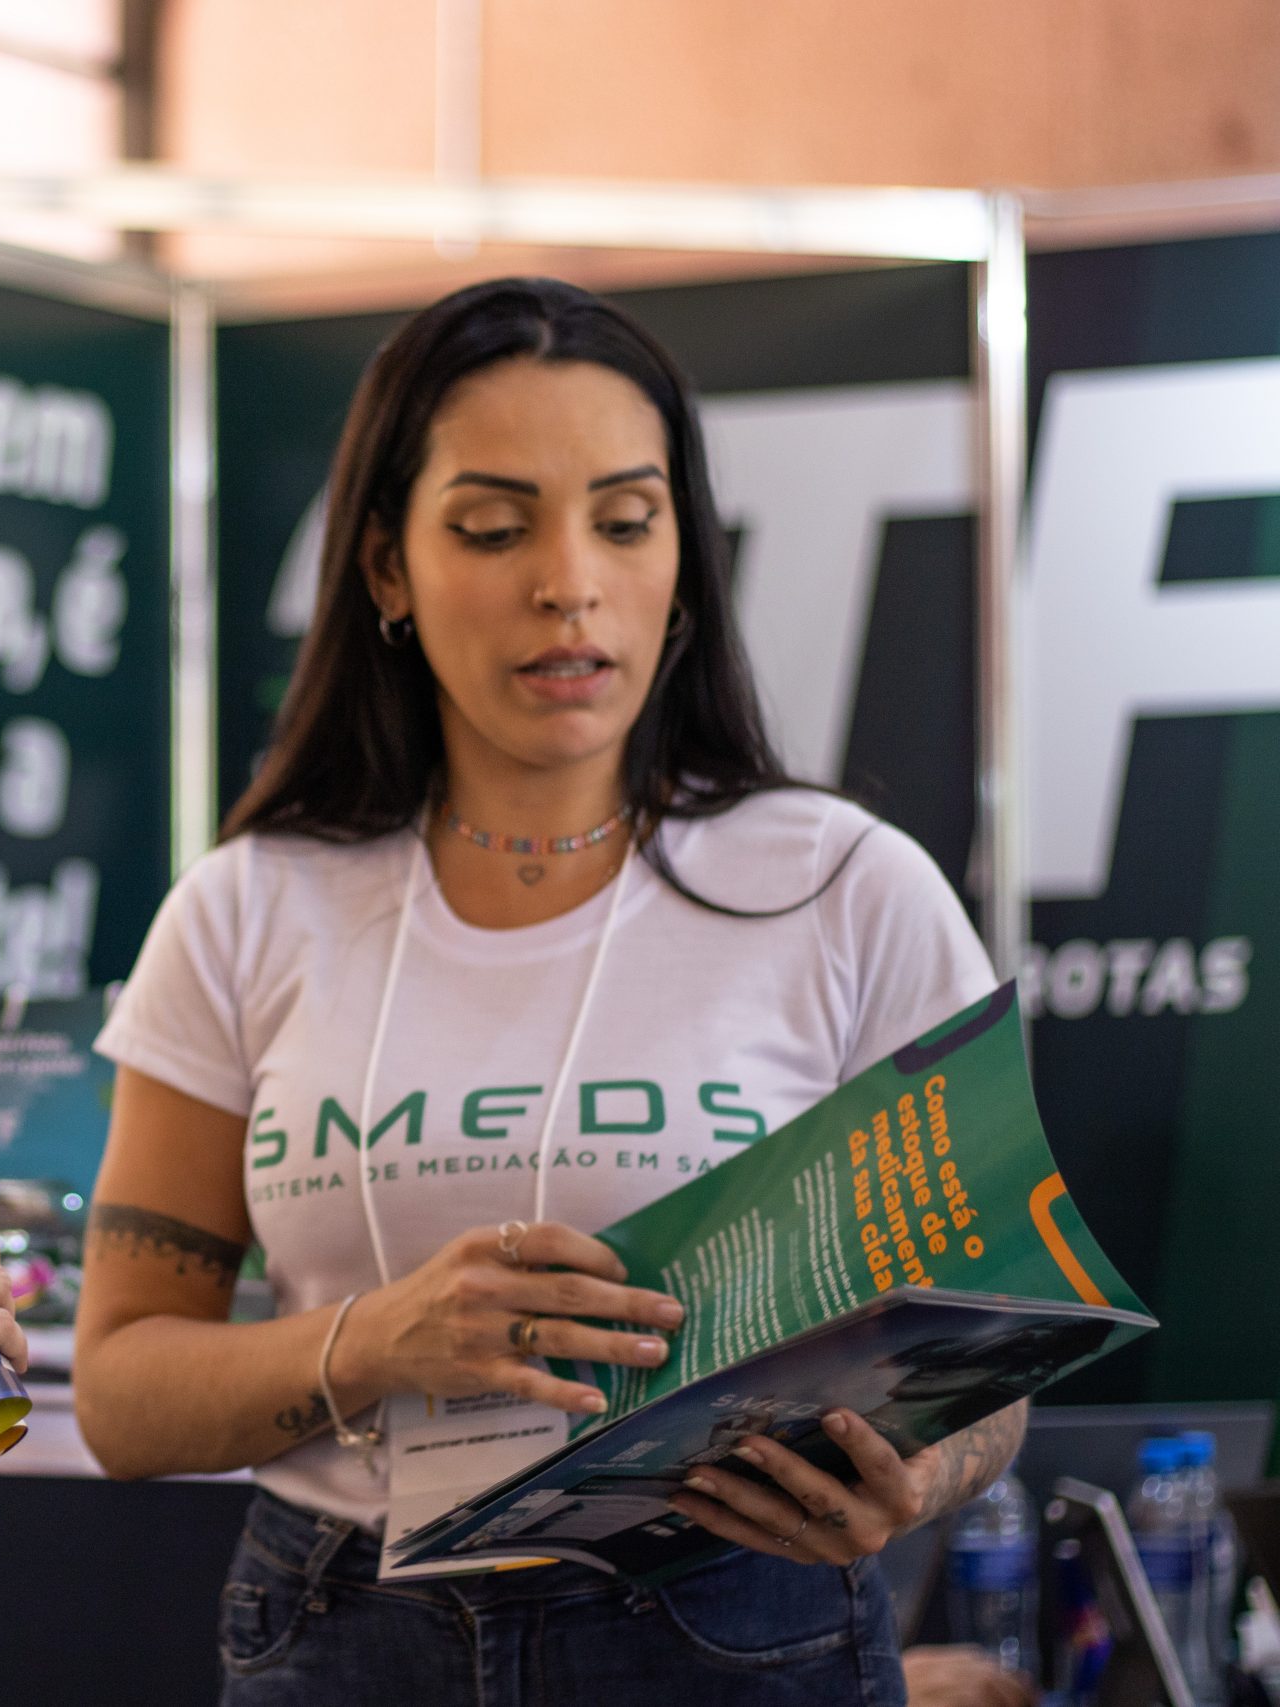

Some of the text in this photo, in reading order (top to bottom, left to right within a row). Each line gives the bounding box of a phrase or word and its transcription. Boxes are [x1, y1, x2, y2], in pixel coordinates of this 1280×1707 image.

[53, 524, 128, 677] é
[252, 1080, 767, 1170] SMEDS
[616, 1152, 659, 1170] EM
[677, 1155, 726, 1174] SA
[848, 1130, 869, 1168] da
[924, 1074, 984, 1259] Como está o
[853, 1168, 873, 1221] sua
[897, 1093, 947, 1255] estoque de
